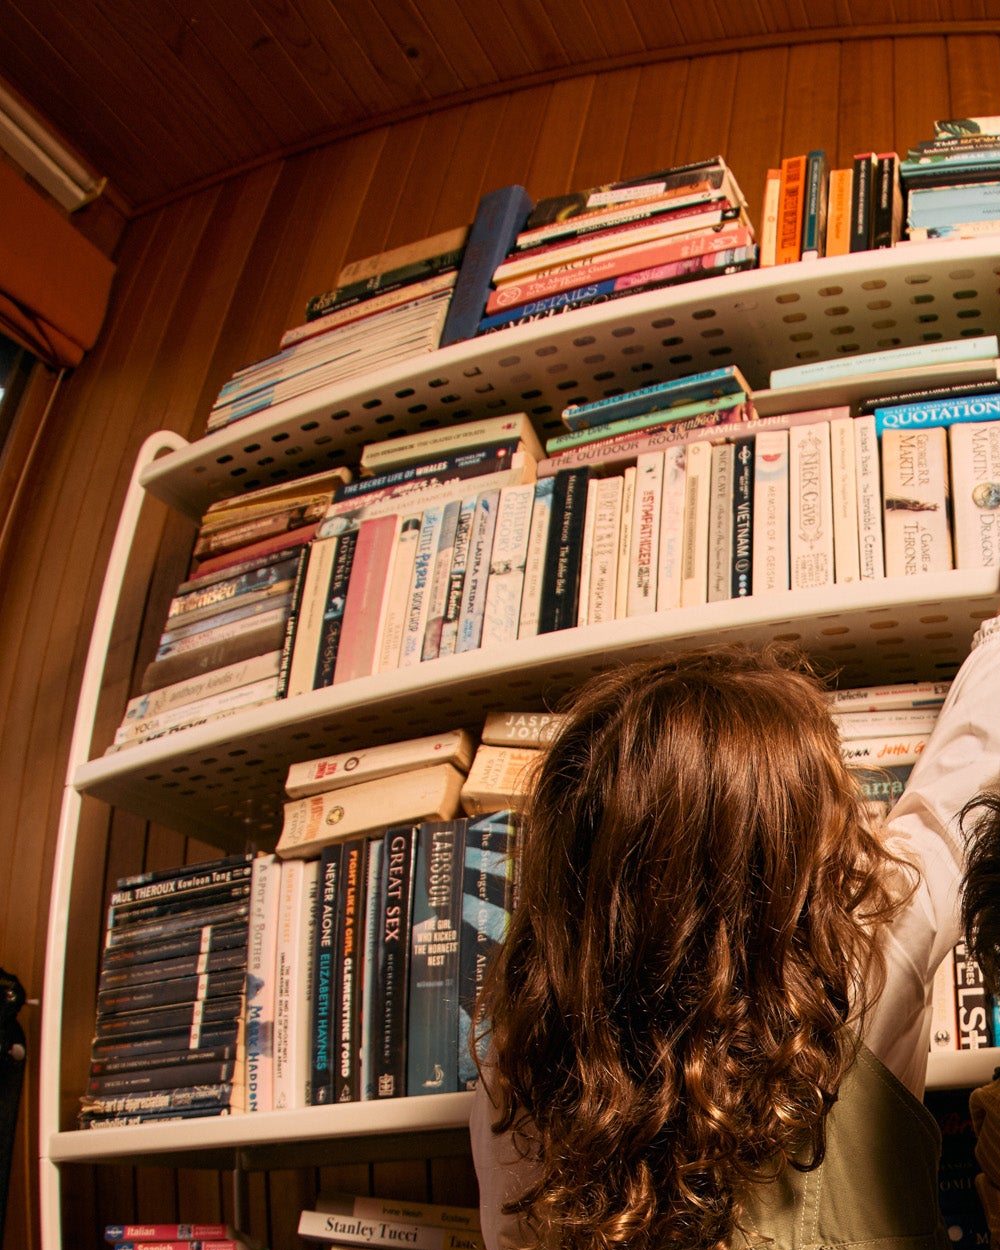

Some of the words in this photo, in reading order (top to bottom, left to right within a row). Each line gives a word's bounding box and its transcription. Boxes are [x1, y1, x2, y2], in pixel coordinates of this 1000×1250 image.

[521, 284, 599, 316] DETAILS
[550, 454, 575, 468] THE
[577, 441, 640, 463] OUTDOOR
[648, 431, 691, 446] ROOM
[697, 422, 741, 437] JAMIE
[745, 415, 790, 430] DURIE
[971, 428, 988, 480] MARTIN
[343, 481, 361, 494] THE
[361, 476, 386, 491] SECRET
[387, 472, 404, 485] LIFE
[415, 461, 448, 477] WHALES
[800, 452, 819, 488] Nick
[899, 434, 915, 488] MARTIN
[766, 485, 775, 530] MEMOIRS
[801, 489, 817, 528] Cave
[735, 501, 751, 558] VIETNAM
[920, 533, 933, 563] GAME
[415, 553, 430, 590] PARIS
[471, 540, 485, 576] LAURA
[765, 553, 775, 590] GEISHA
[466, 578, 479, 614] FRIDAY
[323, 861, 337, 904] NEVER
[348, 850, 358, 888] FIGHT
[388, 835, 408, 900] GREAT
[427, 830, 452, 907] LARSSON
[111, 892, 133, 906] PAUL
[135, 880, 176, 899] THEROUX
[177, 874, 211, 889] Kowloon
[211, 870, 232, 885] Tong
[346, 890, 356, 915] LIKE
[321, 905, 334, 947] ALONE
[384, 905, 401, 943] SEX
[433, 930, 457, 942] KICKED
[344, 929, 354, 957] GIRL
[427, 954, 445, 966] NEST
[318, 953, 331, 1018] ELIZABETH
[342, 957, 354, 1043] CLEMENTINE
[315, 1019, 328, 1071] HAYNES
[340, 1044, 351, 1079] FORD
[126, 1226, 156, 1238] Italian
[324, 1216, 376, 1242] Stanley
[378, 1223, 419, 1244] Tucci
